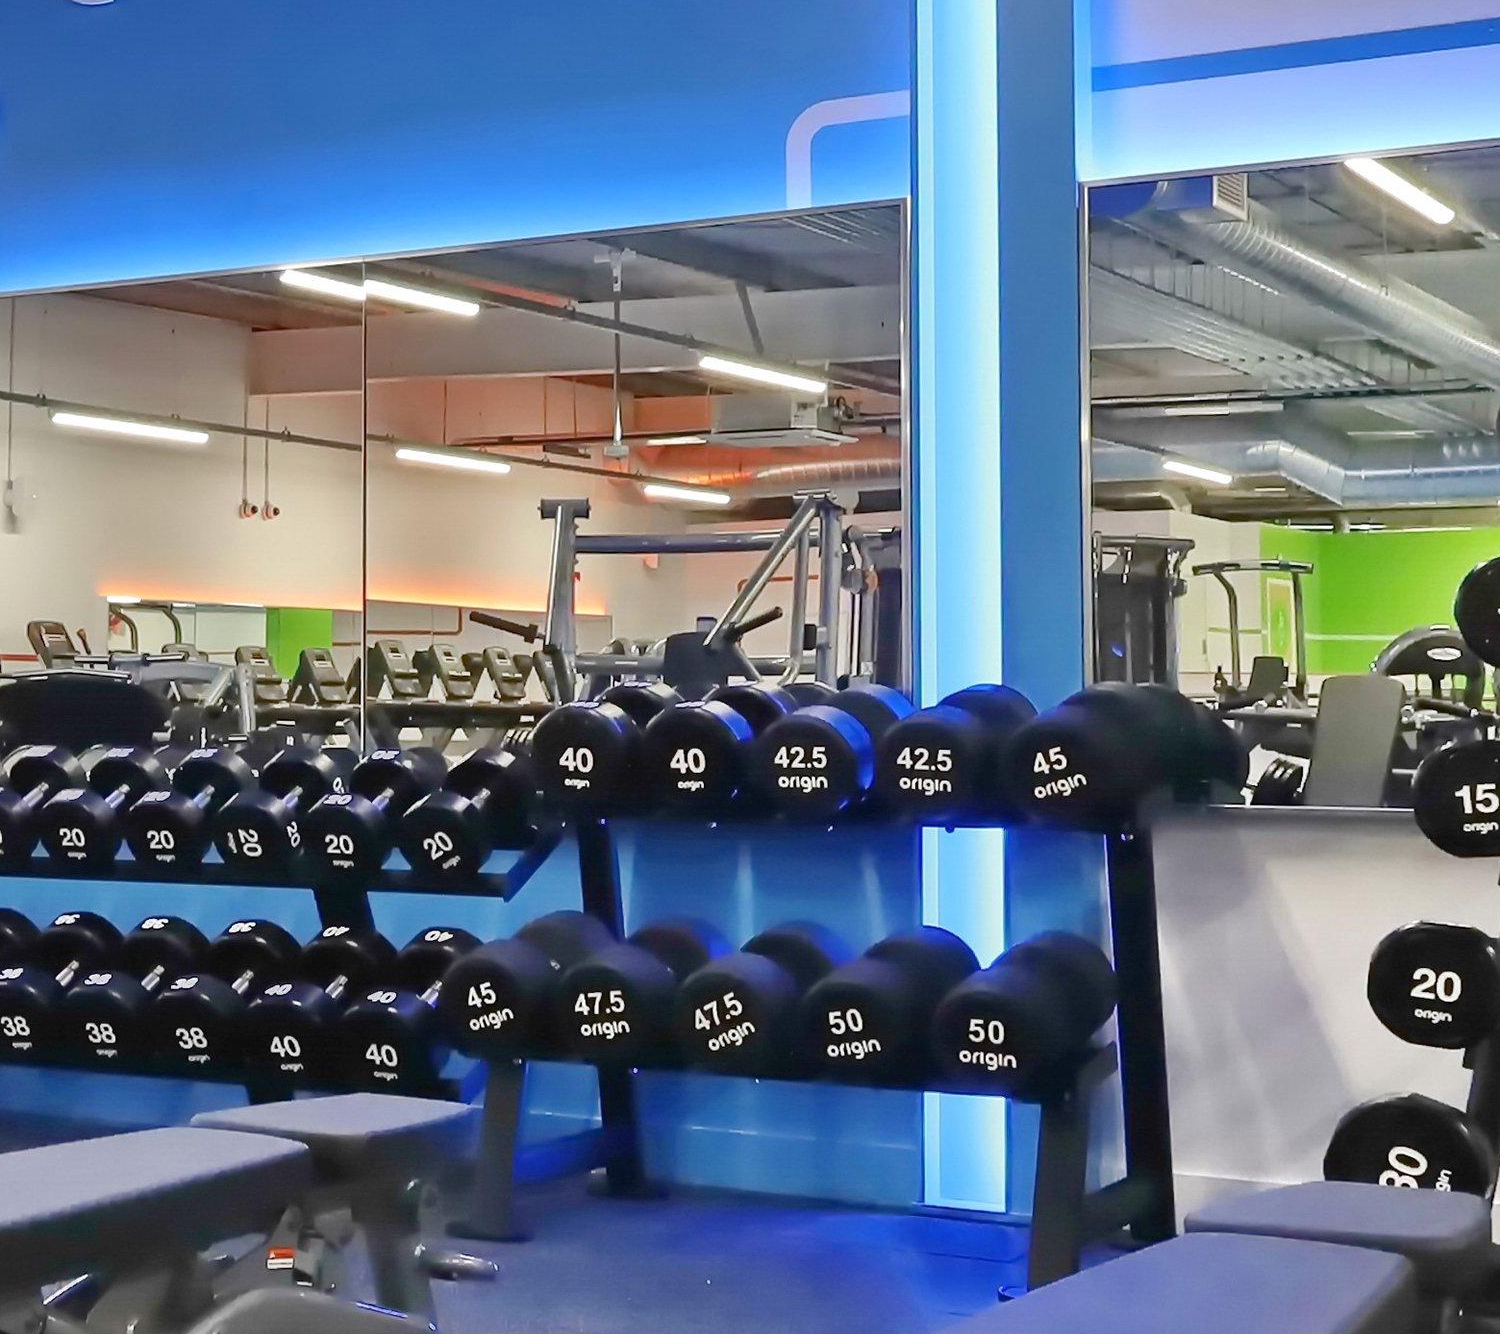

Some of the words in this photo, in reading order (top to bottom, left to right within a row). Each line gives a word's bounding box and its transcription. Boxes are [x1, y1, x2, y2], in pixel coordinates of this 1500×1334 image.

[559, 748, 593, 773] 40
[670, 748, 705, 774] 40
[775, 747, 827, 768] 42.5
[897, 747, 952, 771] 42.5
[1034, 747, 1067, 774] 45
[778, 776, 828, 793] origin
[900, 778, 951, 795] origin
[1034, 774, 1086, 798] origin
[1455, 784, 1499, 813] 15
[60, 828, 85, 847] 20
[287, 821, 300, 847] 20
[1463, 822, 1499, 834] origin
[147, 830, 174, 849] 20
[238, 829, 262, 856] 20
[325, 835, 353, 854] 20
[423, 832, 453, 860] 20
[468, 982, 496, 1007] 45
[1411, 968, 1461, 1002] 20
[575, 990, 625, 1015] 47.5
[695, 992, 742, 1030] 47.5
[1, 1016, 30, 1036] 38
[470, 1009, 513, 1030] origin
[829, 1009, 862, 1034] 50
[1415, 1009, 1452, 1023] origin
[86, 1023, 116, 1043] 38
[176, 1027, 207, 1049] 38
[581, 1021, 630, 1039] origin
[709, 1022, 755, 1050] origin
[969, 1019, 1004, 1044] 50
[271, 1036, 300, 1057] 40
[366, 1044, 397, 1066] 40
[827, 1039, 881, 1059] origin
[959, 1050, 1016, 1070] origin
